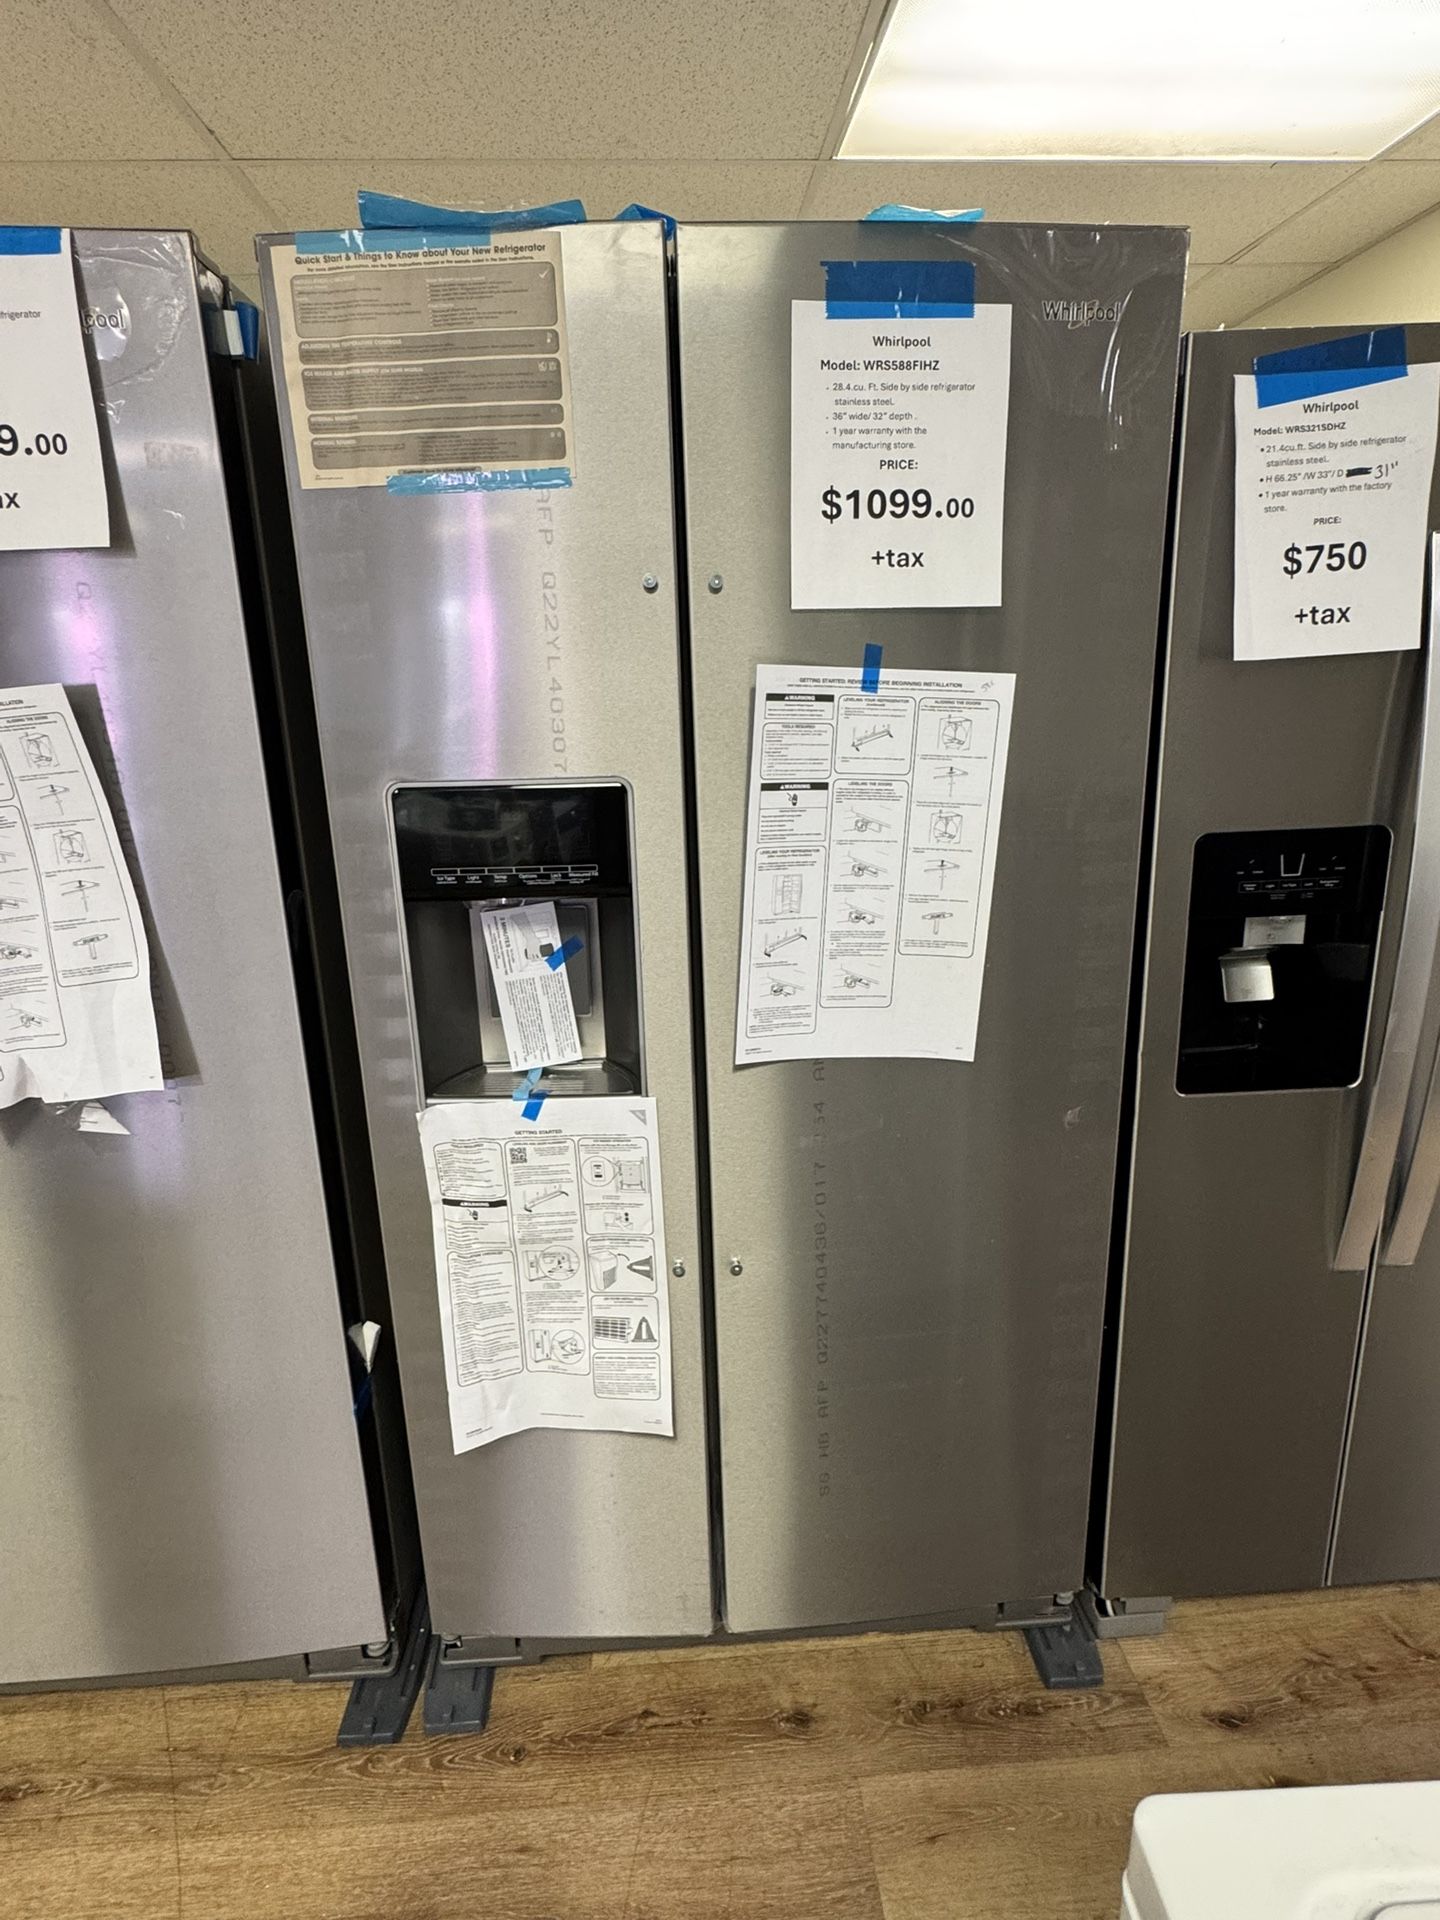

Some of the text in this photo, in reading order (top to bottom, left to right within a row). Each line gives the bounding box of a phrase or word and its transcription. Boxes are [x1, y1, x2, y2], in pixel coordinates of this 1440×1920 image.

[295, 243, 546, 265] Quick Start & Things to Know about Your New Refrigerator
[1042, 300, 1121, 326] Whirlpool
[873, 336, 931, 349] Whirlpool
[821, 360, 939, 370] Model: WRS588FIHZ
[881, 383, 898, 391] Side
[900, 383, 910, 392] by
[912, 383, 929, 391] side
[931, 383, 975, 392] refrigerator
[1303, 400, 1359, 414] Whirlpool
[889, 412, 912, 421] depth
[839, 428, 856, 436] year
[858, 428, 894, 436] warranty
[1254, 427, 1283, 435] Model:
[833, 441, 891, 451] manufacturing
[1308, 441, 1327, 450] Side
[1329, 440, 1339, 450] by
[1341, 439, 1358, 448] side
[1360, 435, 1407, 448] refrigerator
[880, 460, 918, 469] PRICE:
[1266, 456, 1329, 467] stainless steel.
[1337, 469, 1344, 477] D
[1271, 490, 1290, 500] year
[1291, 487, 1329, 498] warranty
[1329, 485, 1348, 494] with
[1350, 483, 1362, 492] the
[1364, 481, 1392, 492] factory
[822, 485, 974, 524] $1099.00
[1313, 516, 1341, 525] PRICE:
[872, 550, 924, 567] +tax
[1283, 541, 1366, 579] $750
[1295, 606, 1350, 625] +tax
